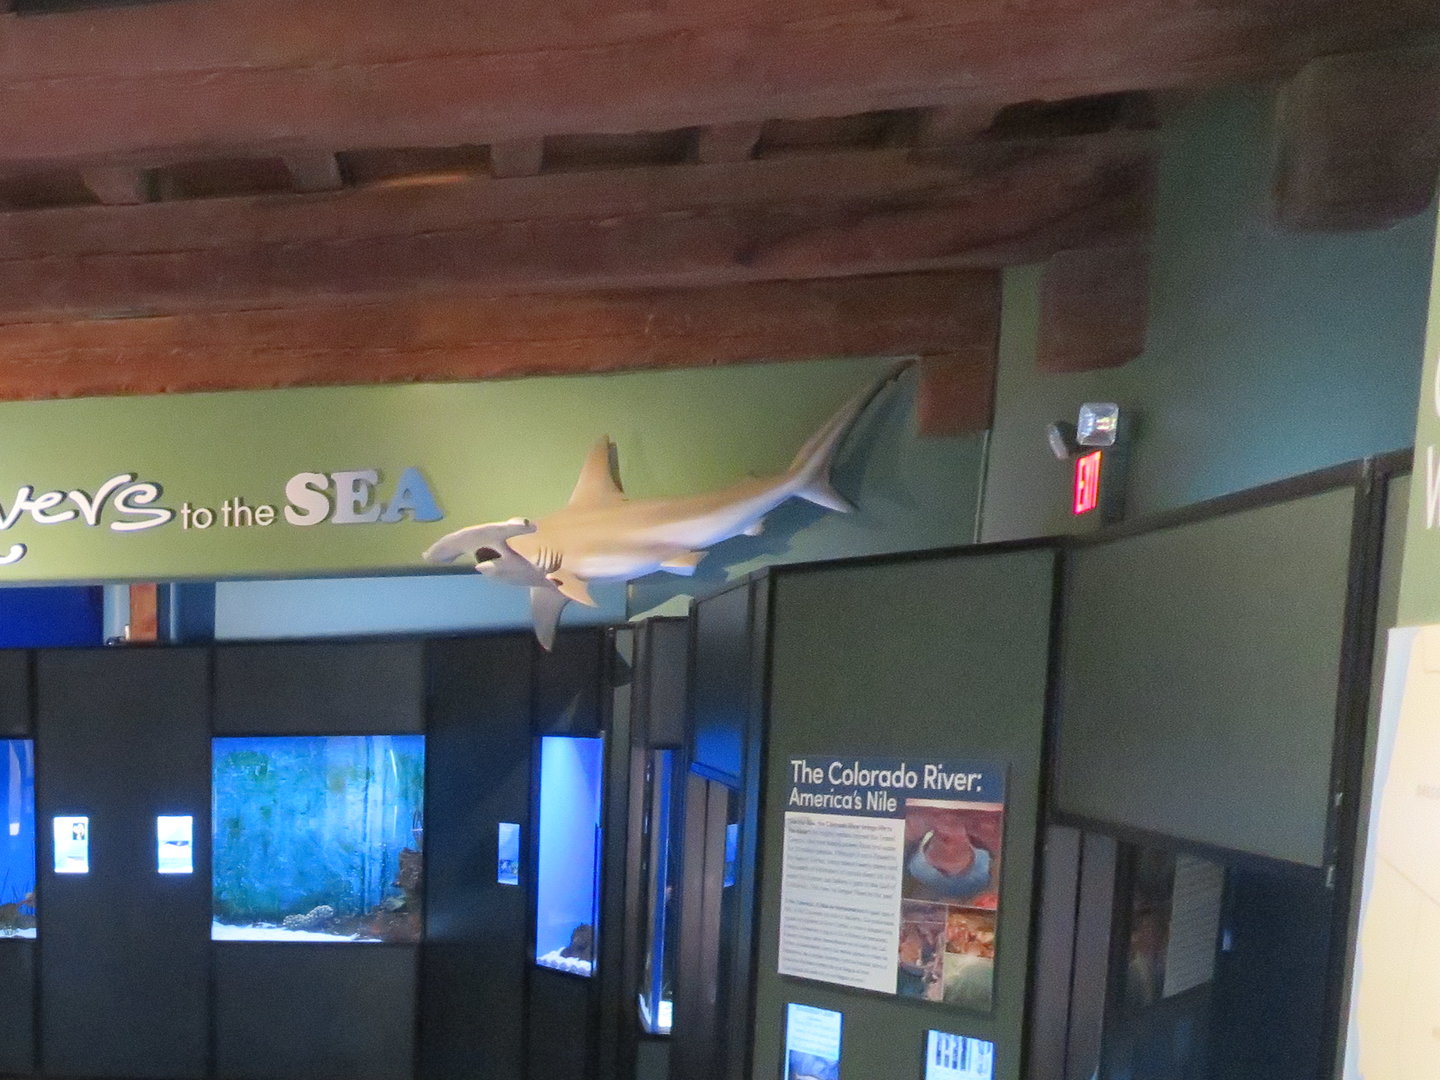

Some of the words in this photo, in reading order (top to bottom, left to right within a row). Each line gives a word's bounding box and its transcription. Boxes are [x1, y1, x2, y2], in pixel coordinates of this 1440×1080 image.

[181, 502, 213, 530] to
[221, 497, 275, 528] the
[284, 466, 444, 526] SEA
[791, 759, 824, 785] The
[828, 761, 918, 789] Colorado
[923, 764, 983, 793] River:
[789, 787, 862, 809] America's
[866, 791, 898, 812] Nile
